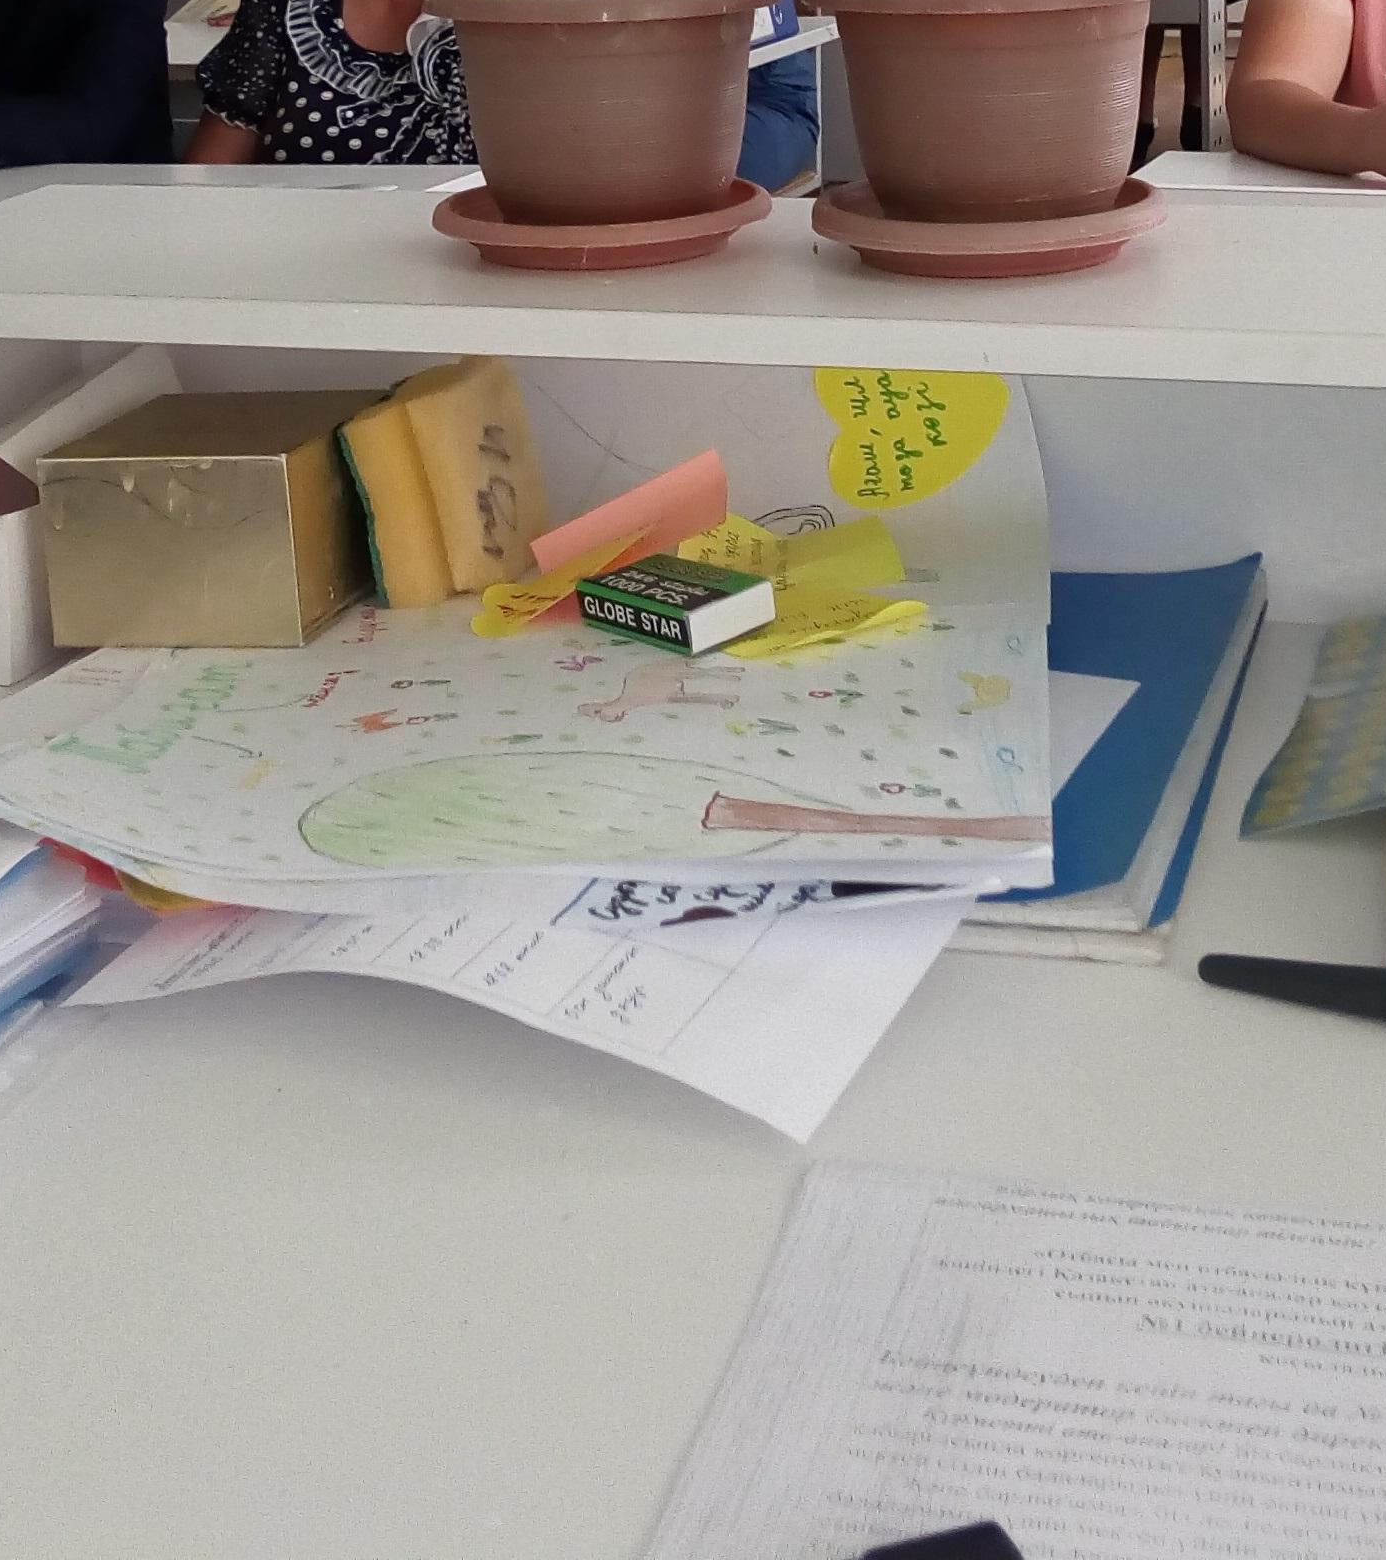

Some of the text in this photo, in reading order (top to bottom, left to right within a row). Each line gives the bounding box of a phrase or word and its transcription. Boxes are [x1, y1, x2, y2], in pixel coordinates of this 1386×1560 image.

[600, 575, 647, 592] 1000
[642, 587, 689, 606] PCS
[584, 595, 638, 628] GLOBE
[640, 612, 682, 640] STAR
